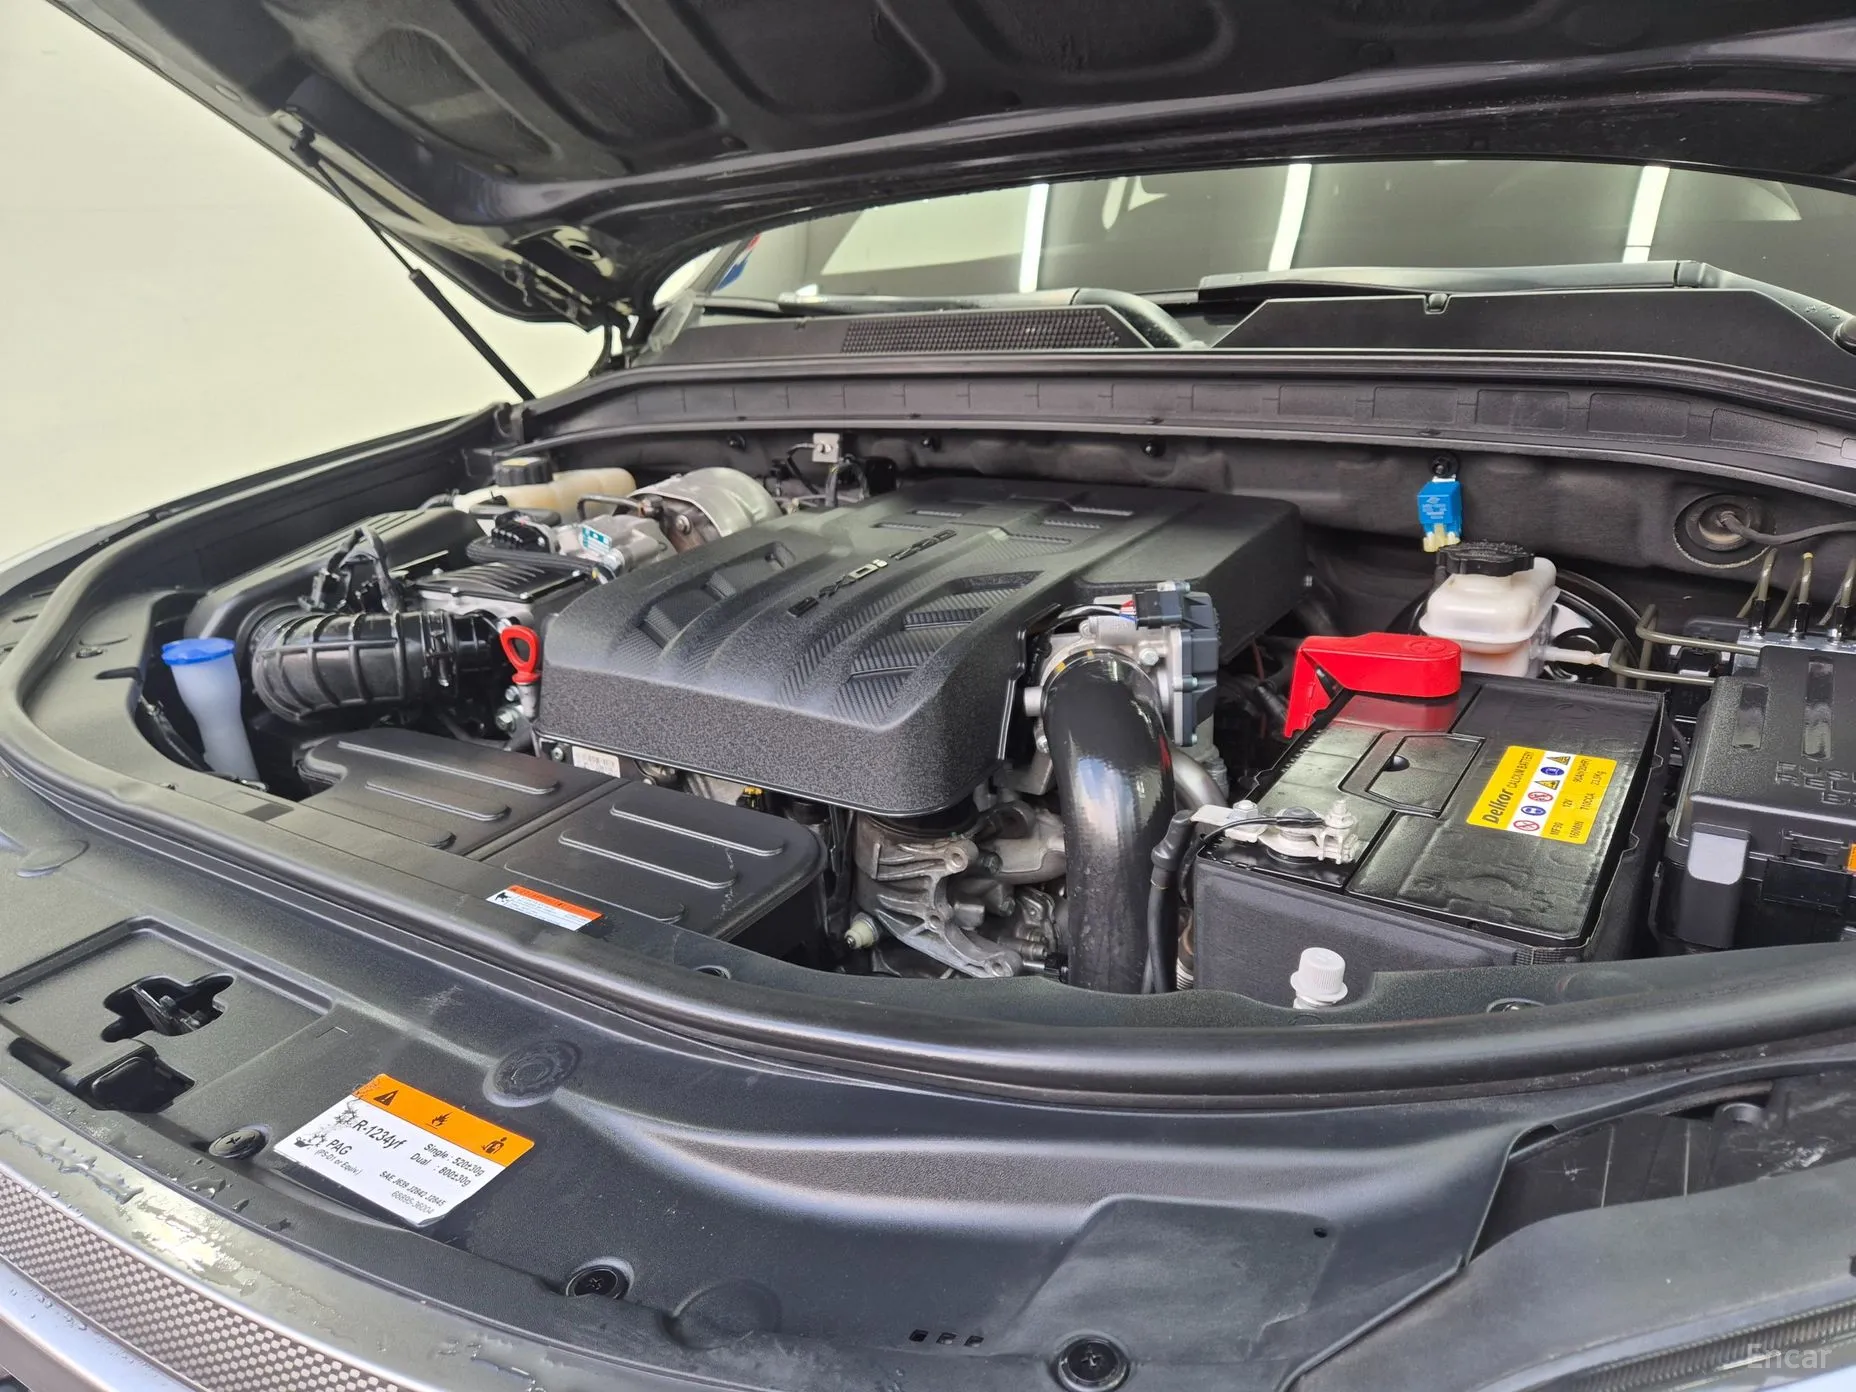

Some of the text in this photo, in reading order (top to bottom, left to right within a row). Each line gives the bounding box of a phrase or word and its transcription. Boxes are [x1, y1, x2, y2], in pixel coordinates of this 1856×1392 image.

[1482, 751, 1534, 824] Delkor CALCIUM BATTERY
[326, 1138, 353, 1156] PAG
[352, 1119, 407, 1149] R-1234yf
[379, 1170, 396, 1182] SAE
[410, 1152, 432, 1166] Dual
[438, 1166, 471, 1187] 800±30g
[424, 1143, 449, 1159] Single
[452, 1157, 485, 1177] 520±30g
